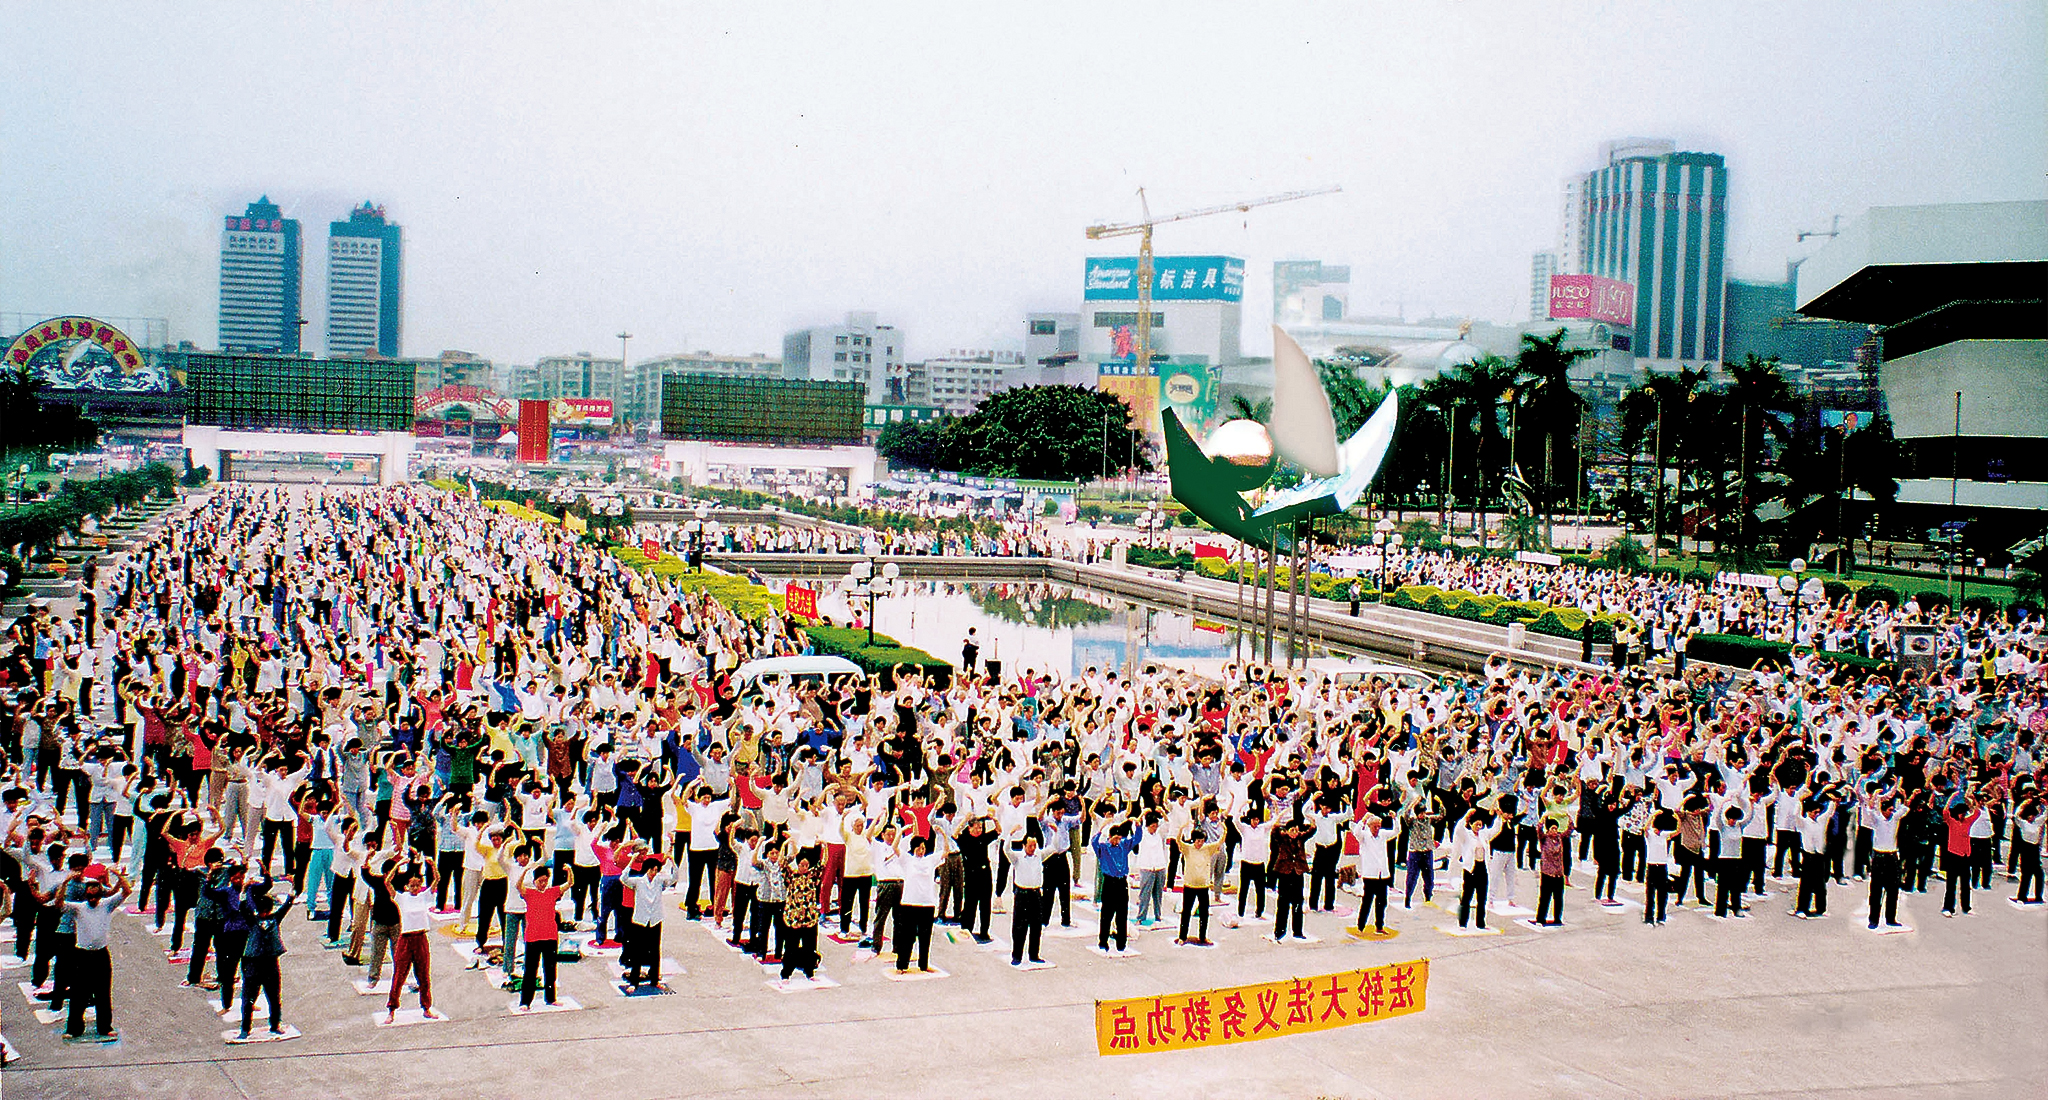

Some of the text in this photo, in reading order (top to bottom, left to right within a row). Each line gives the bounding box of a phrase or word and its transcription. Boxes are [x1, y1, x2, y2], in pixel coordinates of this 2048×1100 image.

[1089, 266, 1131, 278] American
[1087, 277, 1131, 290] Standard
[1552, 285, 1591, 299] JUSCO
[1597, 284, 1628, 320] JUSCO
